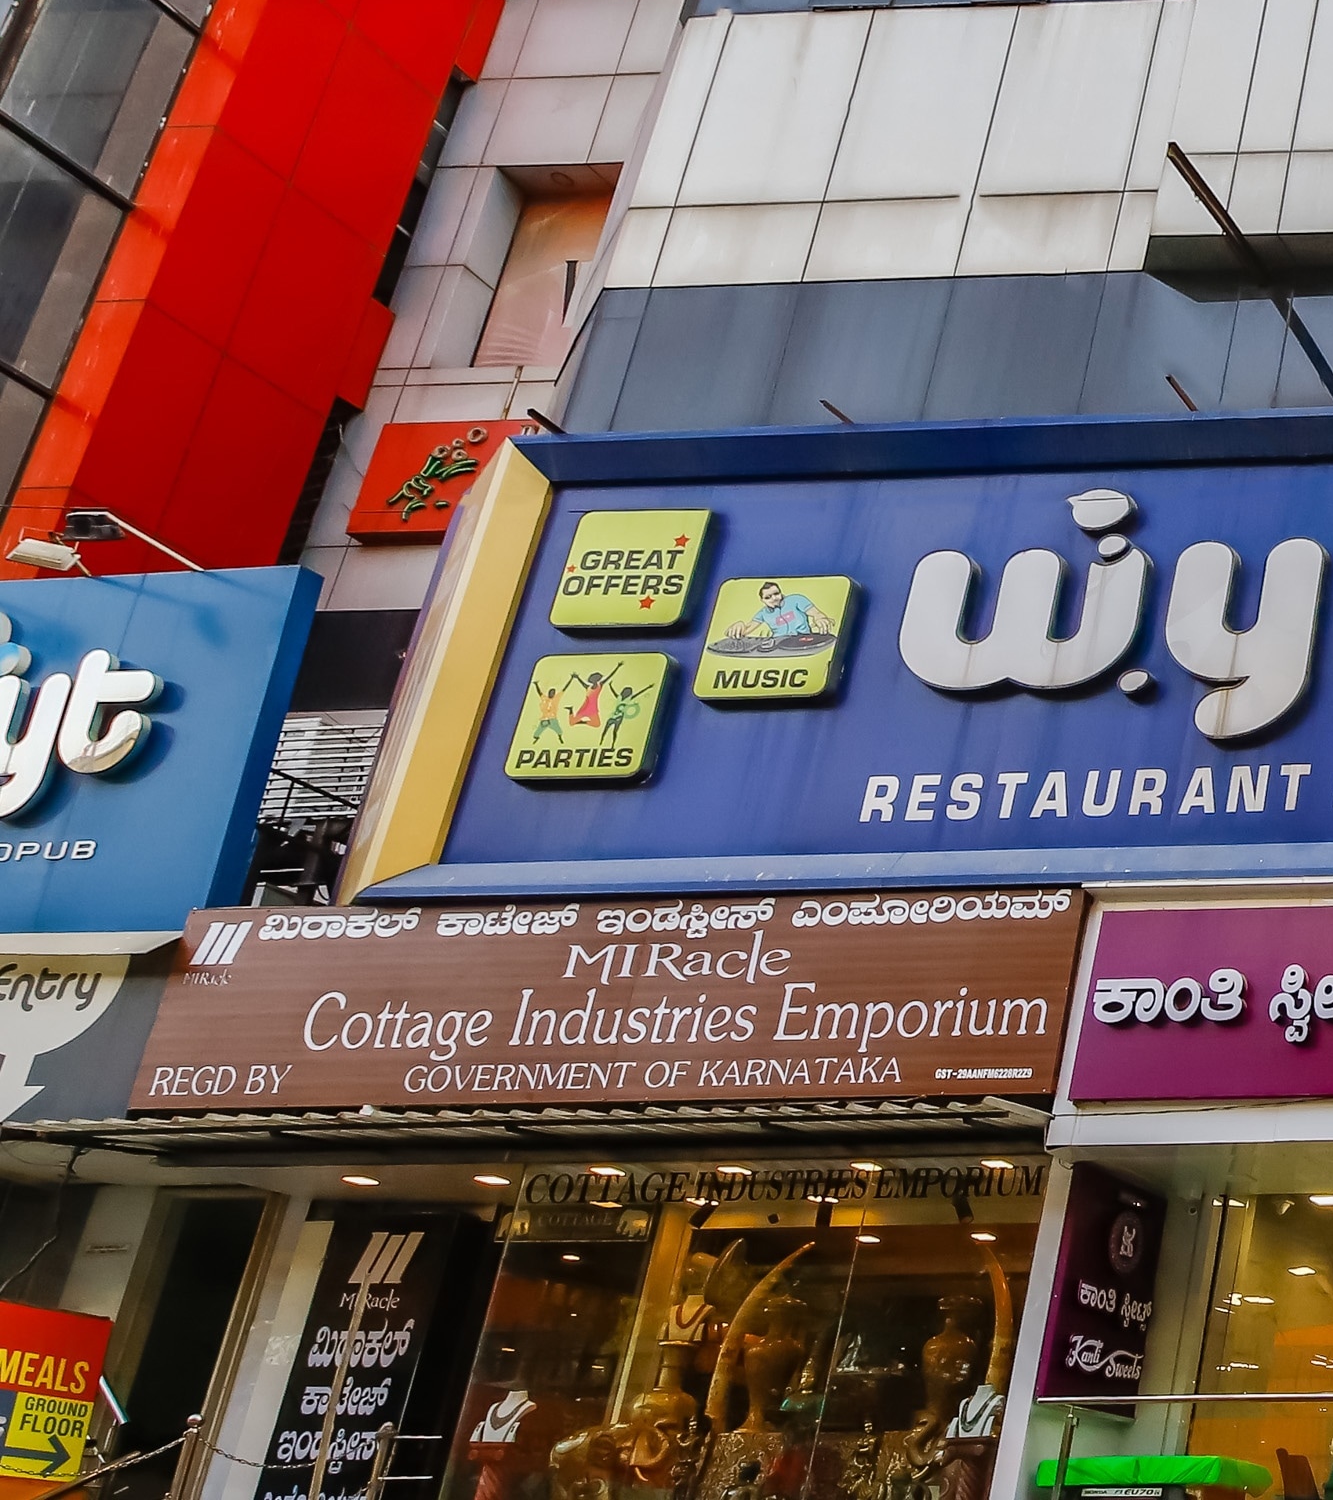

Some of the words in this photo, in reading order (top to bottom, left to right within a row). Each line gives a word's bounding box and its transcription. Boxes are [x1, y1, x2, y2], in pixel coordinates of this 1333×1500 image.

[580, 548, 684, 573] GREAT
[562, 573, 685, 597] OFFERS
[712, 668, 810, 691] MUSIC
[515, 747, 634, 772] PARTIES
[859, 762, 1313, 824] RESTAURANT
[257, 906, 422, 941] ಮಿರಾಕಲ್
[0, 962, 102, 1013] Entry
[1093, 966, 1250, 1026] ಕಾಂತಿ
[303, 989, 493, 1061] Cottage
[508, 987, 757, 1048] Industries
[772, 982, 1050, 1054] Emporium
[148, 1065, 238, 1097] REGD
[243, 1063, 294, 1096] BY
[404, 1060, 640, 1095] GOVERNMENT
[644, 1059, 692, 1089] OF
[697, 1055, 904, 1088] KARNATAKA
[525, 1171, 690, 1204] COTTAGE
[696, 1166, 868, 1200] INDUSTRIES
[871, 1165, 1046, 1199] EMPORIUM
[339, 1288, 401, 1312] MRacle
[1066, 1334, 1104, 1373] Kanti
[0, 1348, 91, 1395] MEALS
[25, 1396, 89, 1418] GROUND
[19, 1412, 85, 1438] FLOOR
